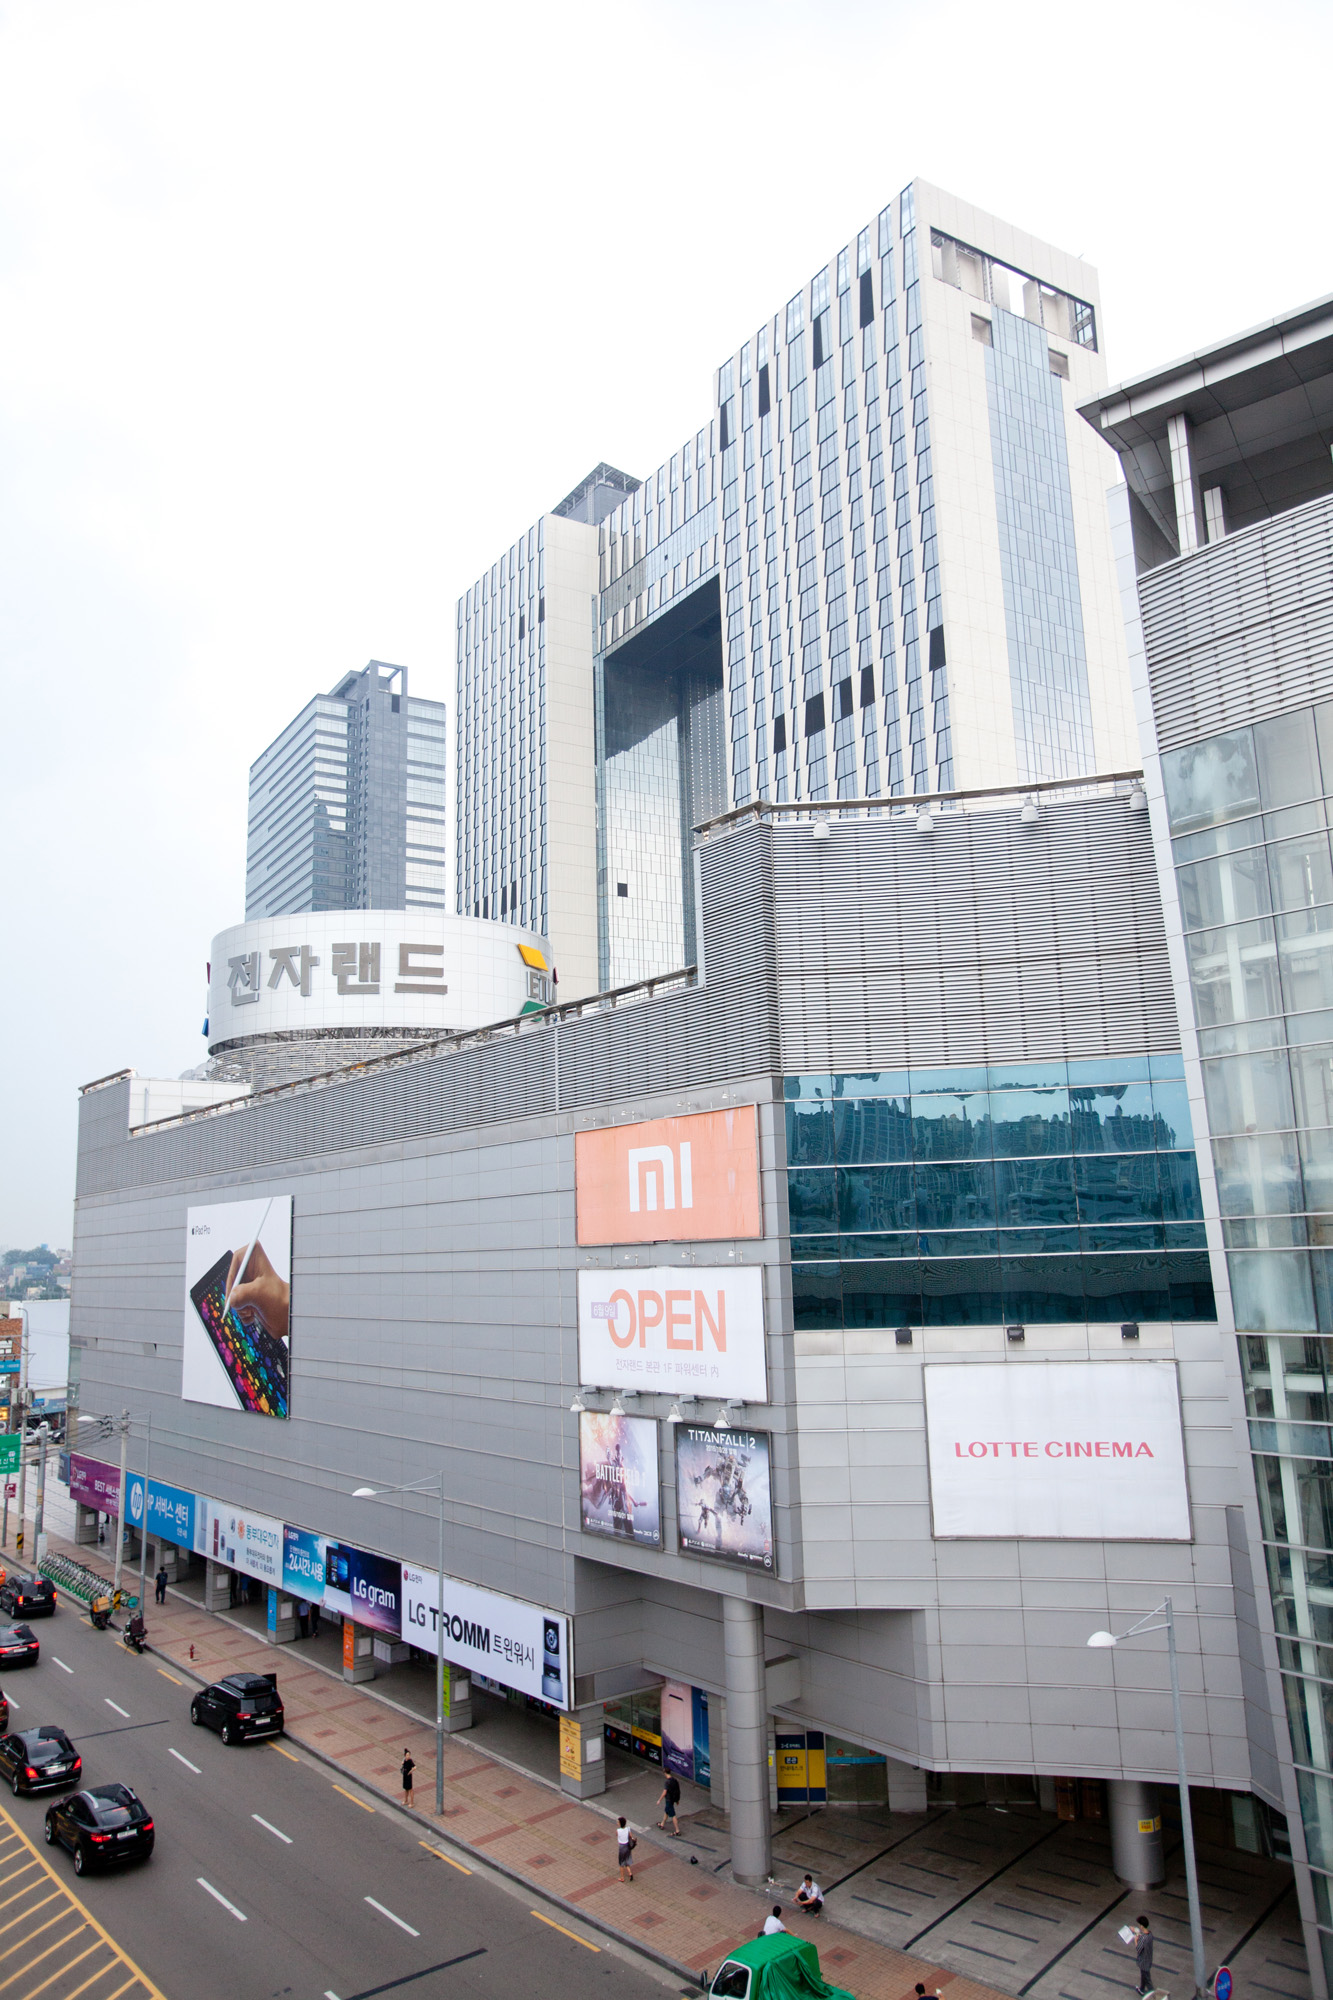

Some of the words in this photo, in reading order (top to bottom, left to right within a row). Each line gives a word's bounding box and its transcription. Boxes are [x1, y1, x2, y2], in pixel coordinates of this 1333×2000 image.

[227, 942, 448, 1006] 전자랜드
[607, 1288, 727, 1352] OPEN
[616, 1359, 643, 1372] 전자랜드
[646, 1361, 661, 1374] 본관
[663, 1362, 673, 1373] 1F
[675, 1362, 707, 1377] 파워센터
[688, 1429, 745, 1448] TITANFALL
[955, 1441, 1039, 1458] LOTTE
[1044, 1441, 1155, 1458] CINEMA
[595, 1463, 640, 1487] BATTLEFIELD
[154, 1495, 173, 1519] 서비스
[175, 1503, 188, 1527] 센터
[246, 1524, 279, 1550] 동부대우전자
[289, 1554, 310, 1577] 24시간
[310, 1562, 324, 1582] 사용
[409, 1573, 423, 1584] LG전자
[353, 1576, 367, 1599] LG
[368, 1584, 396, 1610] gram
[408, 1599, 426, 1627] LG
[429, 1606, 490, 1654] TROMM
[493, 1634, 535, 1671] 트윈워시
